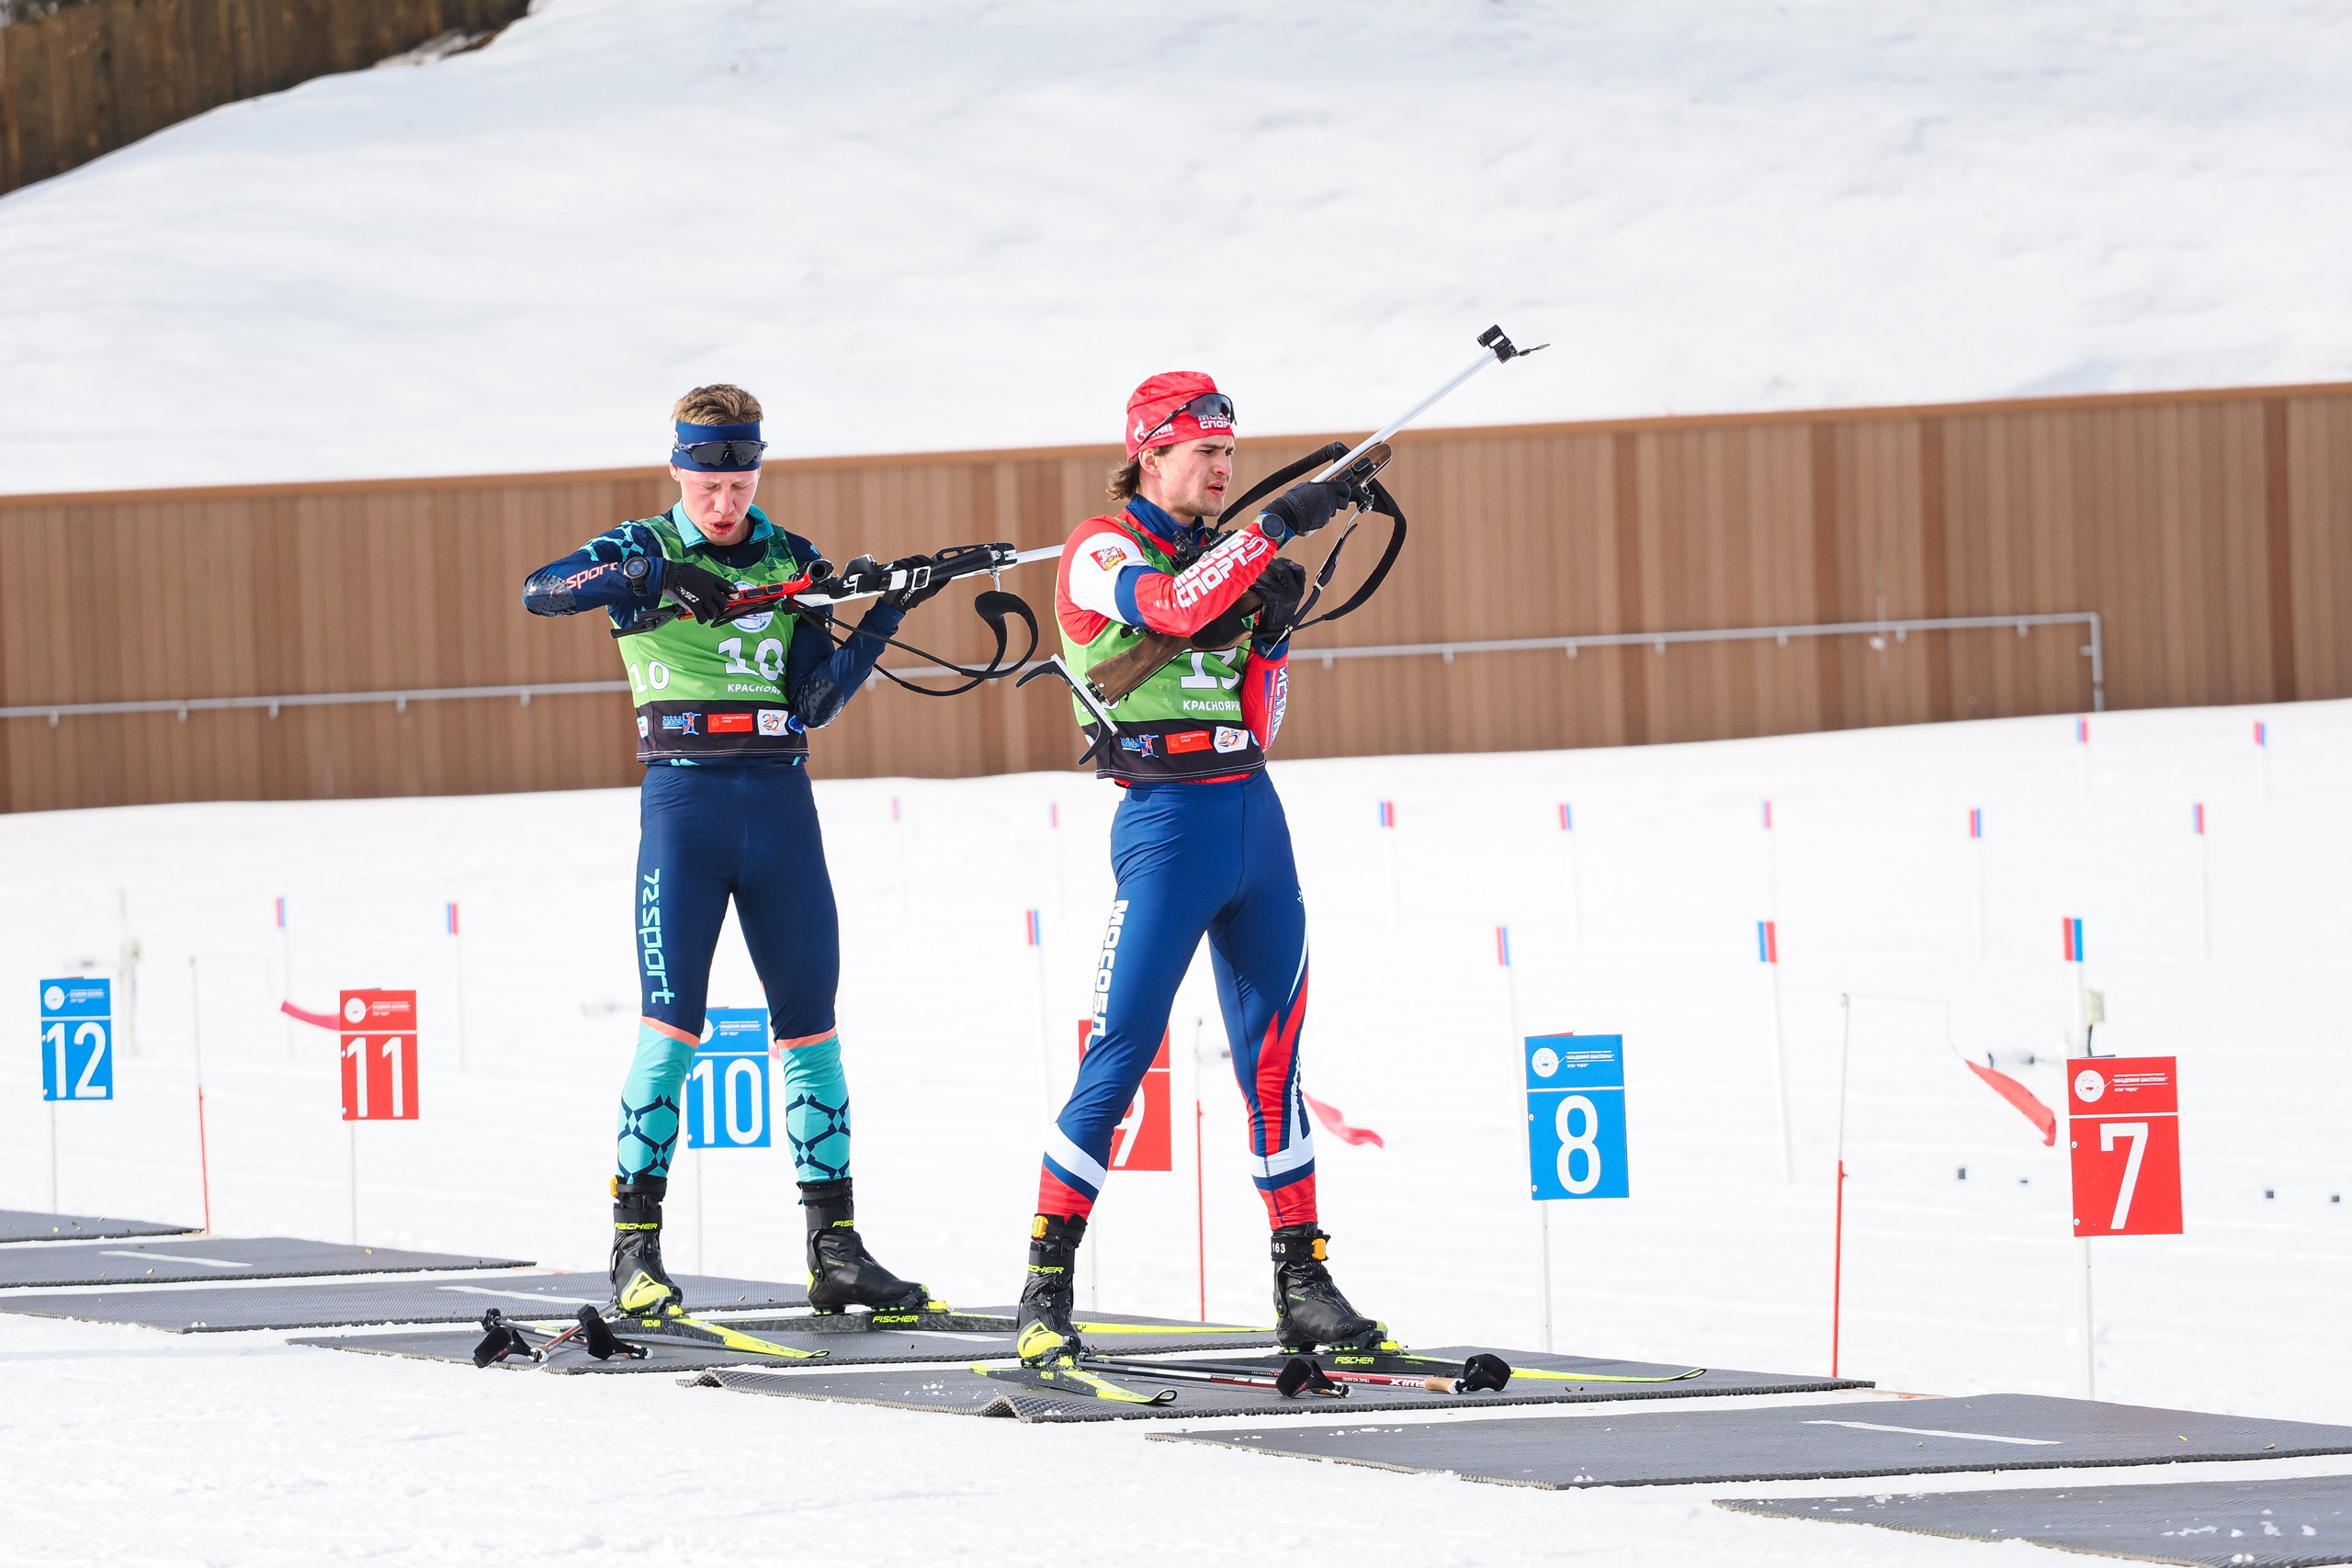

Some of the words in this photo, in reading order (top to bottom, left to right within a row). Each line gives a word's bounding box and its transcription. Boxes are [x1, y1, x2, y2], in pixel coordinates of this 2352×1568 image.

[1176, 545, 1249, 608] СПОРТ
[628, 660, 671, 695] 10
[718, 637, 785, 682] 10
[47, 1021, 107, 1098] 12
[346, 1037, 403, 1117] 11
[693, 1058, 763, 1145] 10
[1555, 1095, 1601, 1194] 8
[2099, 1122, 2149, 1230] 7
[1272, 1242, 1286, 1254] 163
[641, 1319, 662, 1327] FISCHER
[872, 1314, 919, 1324] FISCHER
[1334, 1356, 1375, 1365] FISCHER
